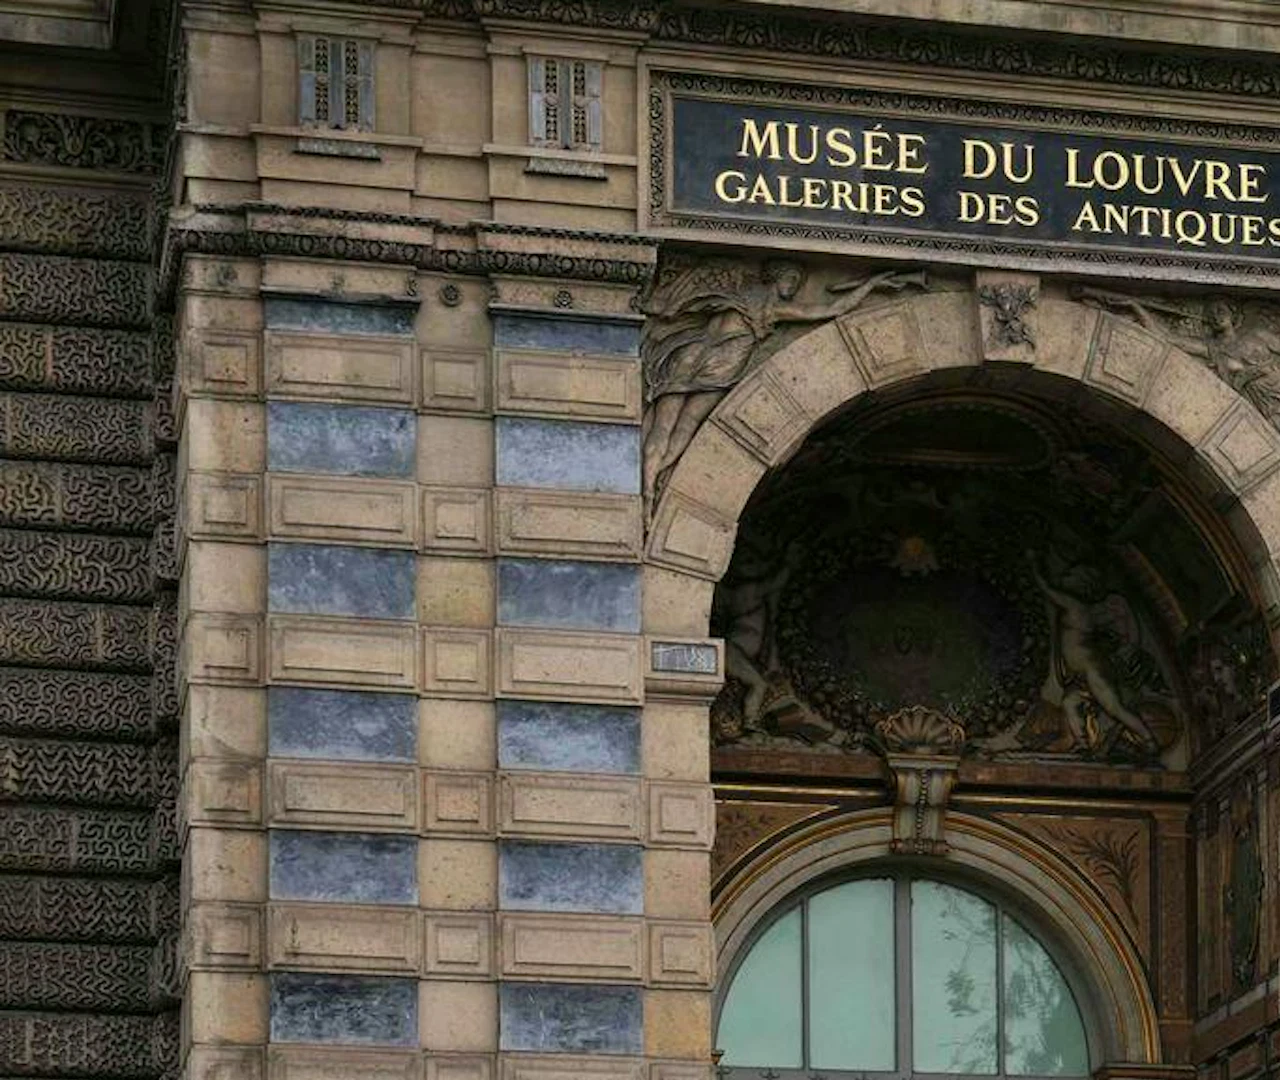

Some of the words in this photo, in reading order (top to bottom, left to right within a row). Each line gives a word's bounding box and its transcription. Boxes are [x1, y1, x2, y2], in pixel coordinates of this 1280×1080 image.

[737, 119, 928, 173] MUSÉE
[963, 139, 1035, 184] DU
[1066, 147, 1269, 203] LOUVRE
[715, 171, 925, 217] GALERIES
[959, 193, 1039, 227] DES
